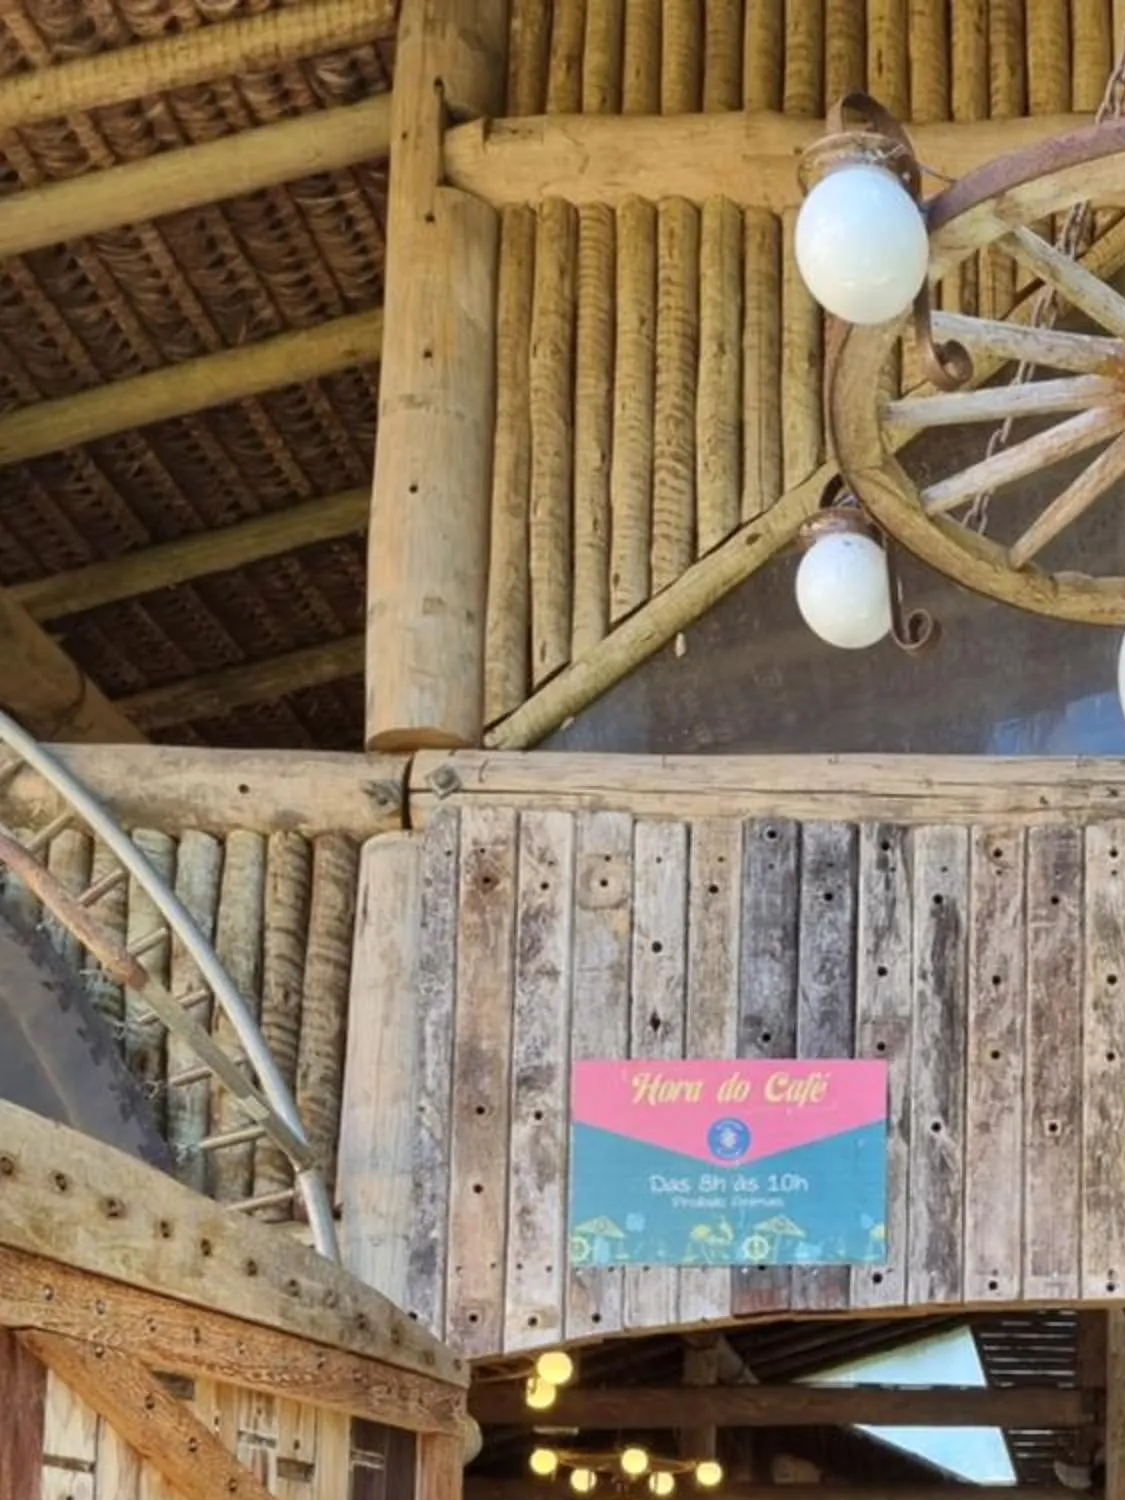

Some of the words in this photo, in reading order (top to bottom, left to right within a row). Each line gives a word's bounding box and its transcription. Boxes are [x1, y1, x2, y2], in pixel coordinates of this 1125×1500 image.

[631, 1072, 703, 1106] Hora
[717, 1071, 750, 1103] do
[764, 1071, 830, 1108] Café
[649, 1174, 691, 1193] Das
[699, 1173, 726, 1193] 8h
[767, 1173, 809, 1193] 10h
